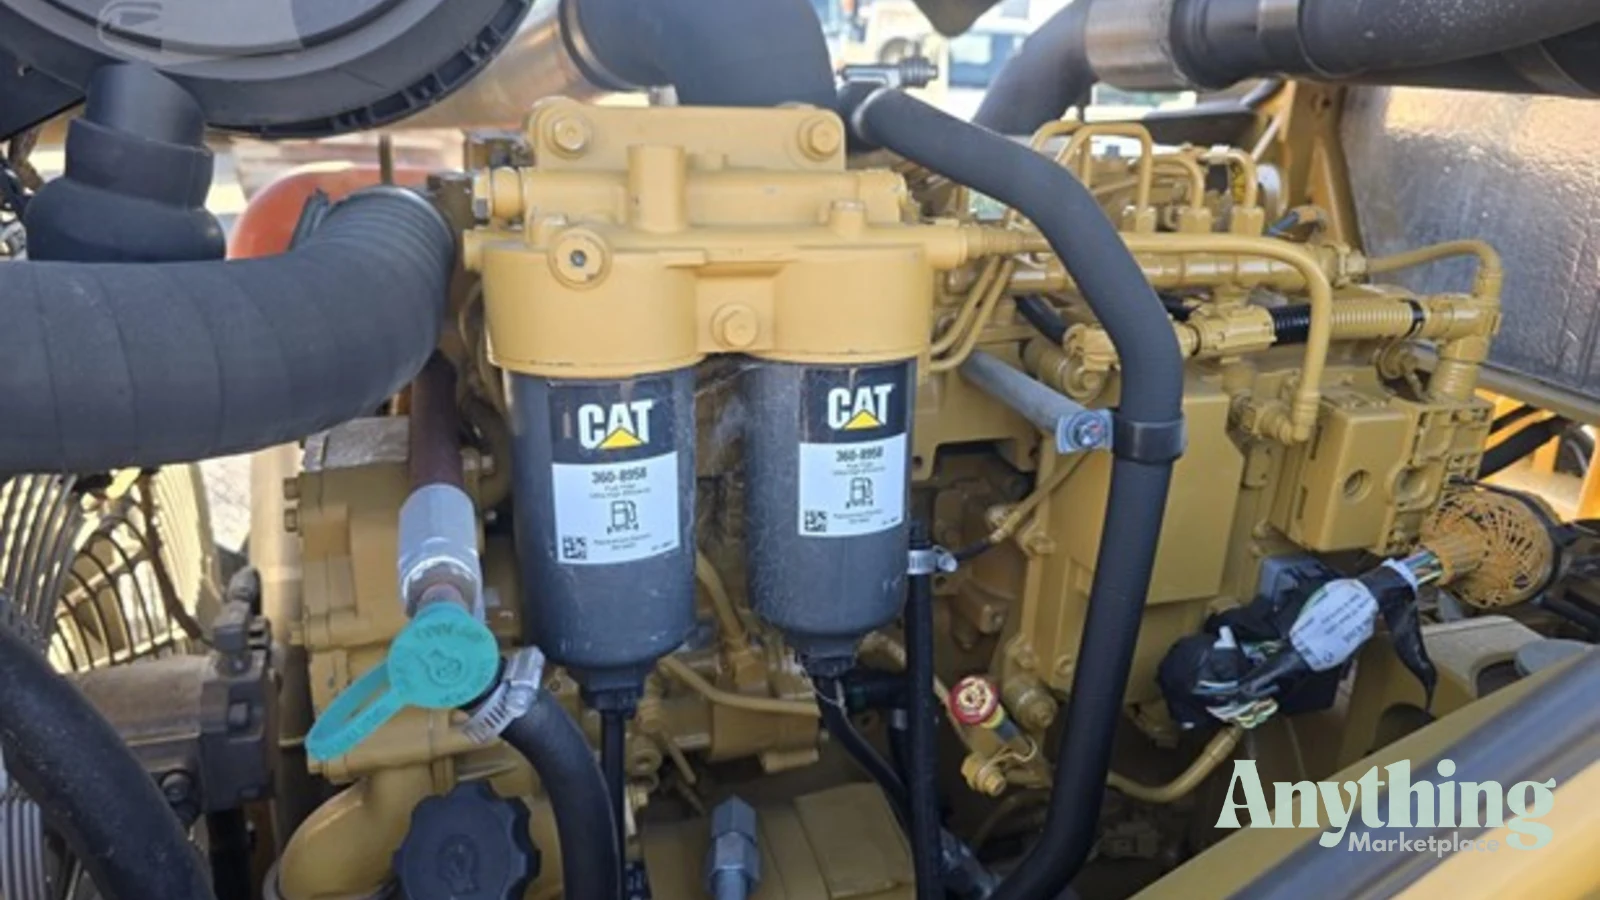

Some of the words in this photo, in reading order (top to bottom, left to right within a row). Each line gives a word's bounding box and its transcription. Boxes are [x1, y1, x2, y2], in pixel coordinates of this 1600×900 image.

[577, 399, 654, 450] CAT
[827, 383, 894, 430] CAT
[591, 466, 647, 484] 360-8958
